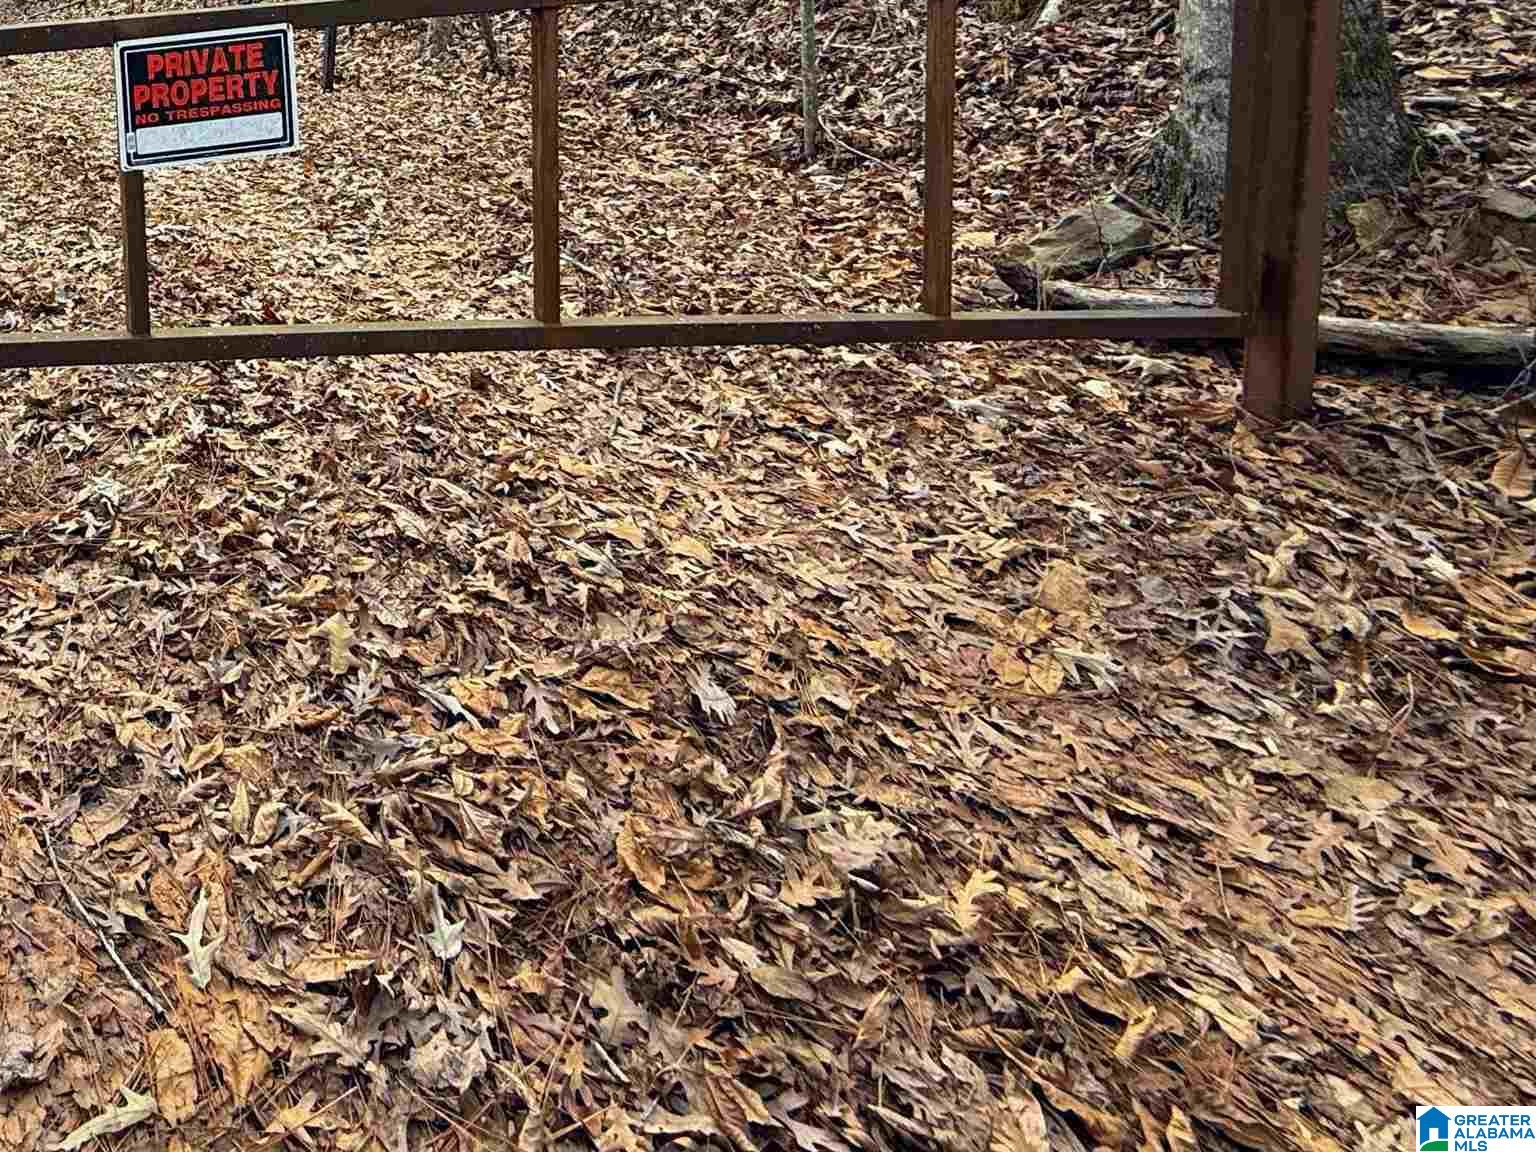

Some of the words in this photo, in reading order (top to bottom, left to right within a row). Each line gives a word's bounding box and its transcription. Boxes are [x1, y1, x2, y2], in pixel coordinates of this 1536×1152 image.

[146, 42, 264, 80] PRIVATE
[133, 69, 279, 110] PROPERTY
[135, 112, 160, 125] NO
[167, 98, 282, 121] TRESPASSING
